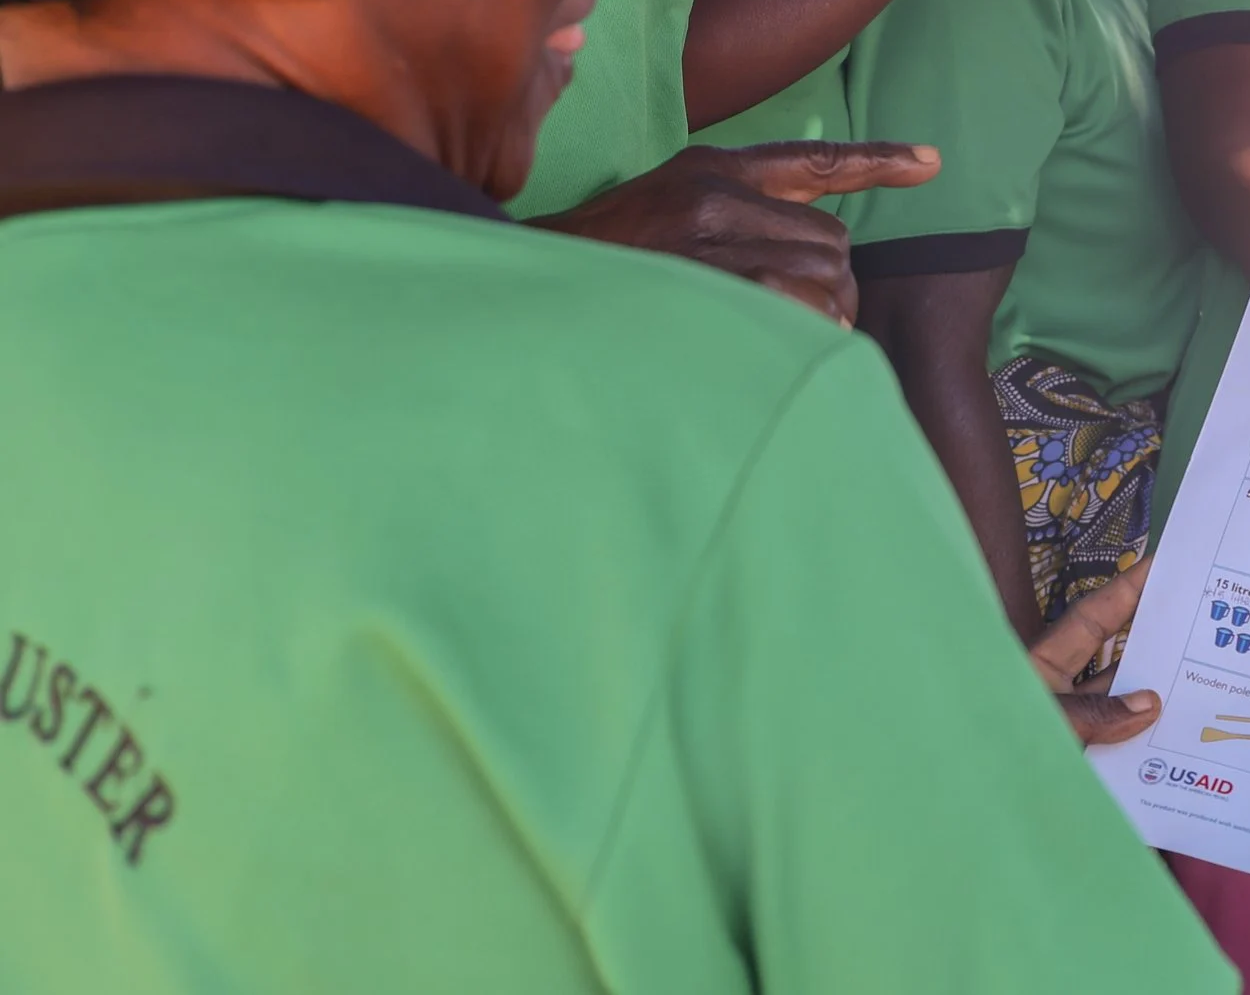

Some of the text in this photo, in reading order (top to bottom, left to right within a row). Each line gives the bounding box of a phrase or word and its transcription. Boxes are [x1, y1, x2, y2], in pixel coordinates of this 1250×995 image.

[1216, 578, 1229, 590] 15
[1186, 670, 1228, 692] Wooden
[0, 629, 178, 870] USTER
[1169, 766, 1234, 795] USAID
